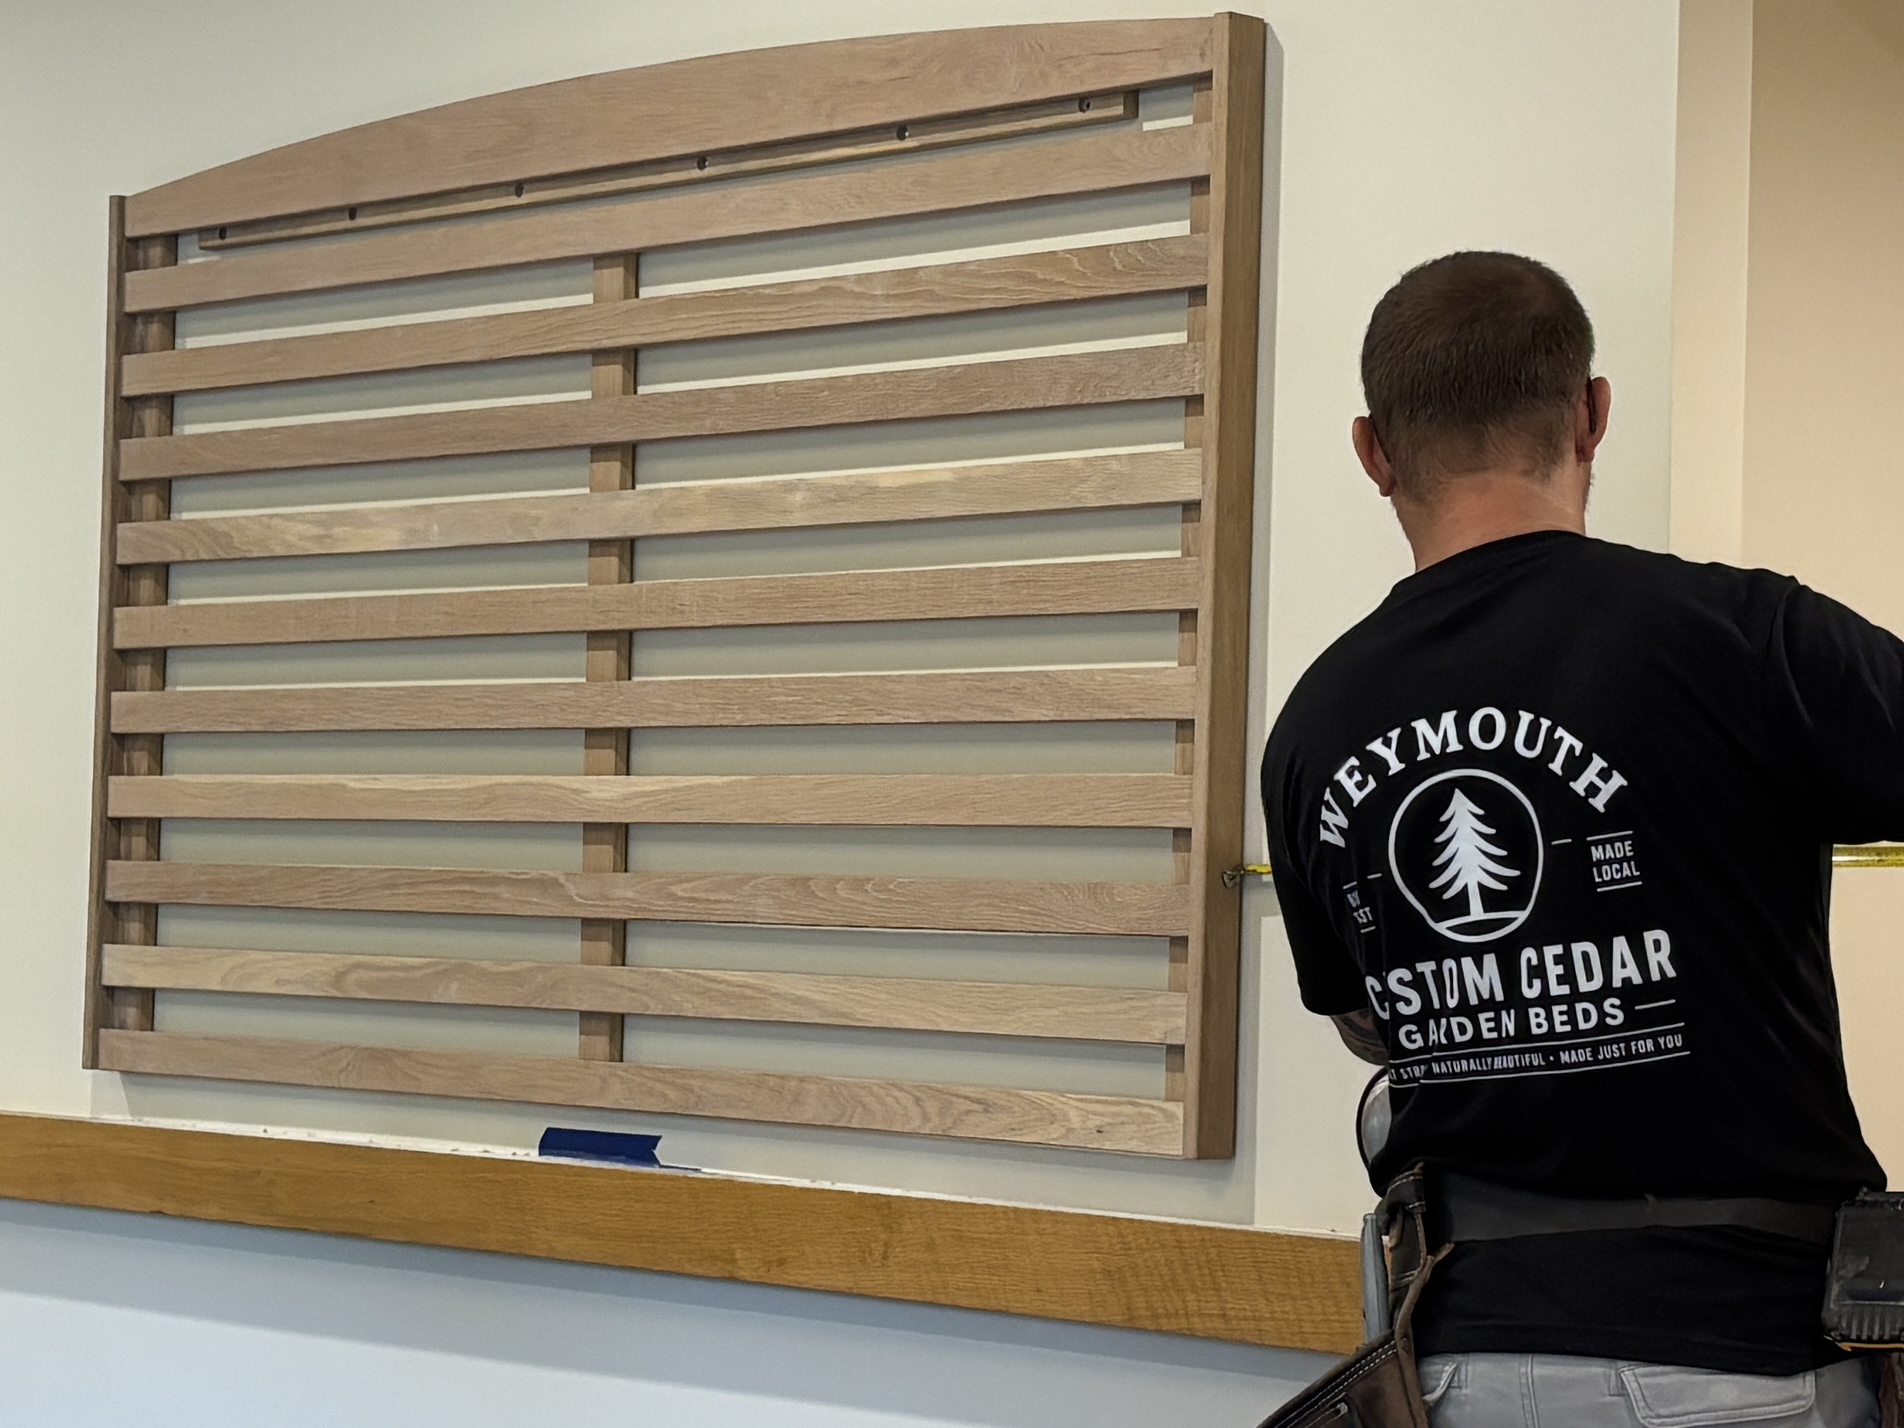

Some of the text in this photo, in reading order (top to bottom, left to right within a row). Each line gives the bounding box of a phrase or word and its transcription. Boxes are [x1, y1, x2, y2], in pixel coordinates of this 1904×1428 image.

[1319, 706, 1628, 849] WEYMOUTH
[1590, 840, 1634, 862] MADE
[1592, 860, 1641, 882] LOCAL
[1365, 929, 1677, 1020] CSTOM CEDAR
[1528, 997, 1625, 1035] BEDS
[1431, 1056, 1492, 1075] NATURALLY
[1559, 1047, 1594, 1065] MADE
[1597, 1042, 1626, 1060] JUST
[1630, 1038, 1655, 1055] FOR
[1657, 1033, 1683, 1049] YOU
